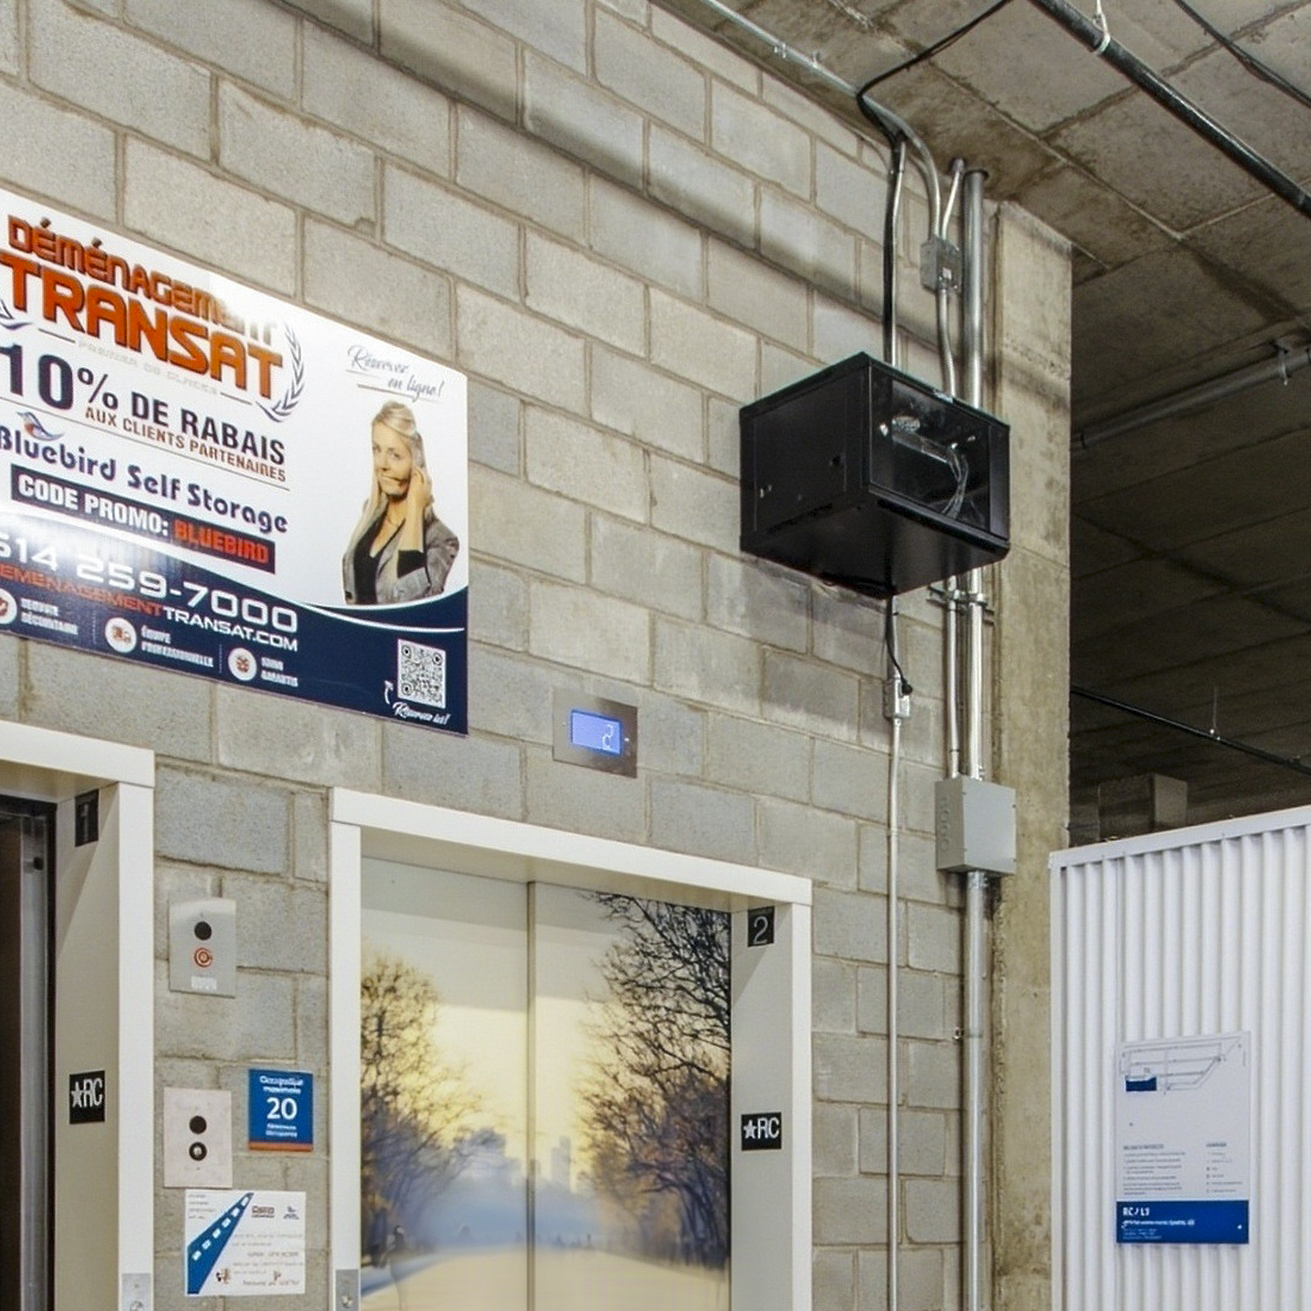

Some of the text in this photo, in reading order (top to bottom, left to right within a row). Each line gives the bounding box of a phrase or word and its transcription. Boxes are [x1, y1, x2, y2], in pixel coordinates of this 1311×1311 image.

[85, 407, 286, 482] AUX CLIENTS PARTENAIRES
[131, 391, 169, 427] DE
[181, 408, 286, 466] RABAIS
[18, 473, 270, 564] CODE PROMO: BLUEBIRD
[127, 465, 181, 500] Self
[187, 483, 288, 535] Storage
[76, 553, 298, 634] 259-7000
[753, 915, 769, 945] 2
[83, 1077, 103, 1107] RC
[267, 1097, 298, 1120] 20
[757, 1116, 780, 1139] RC
